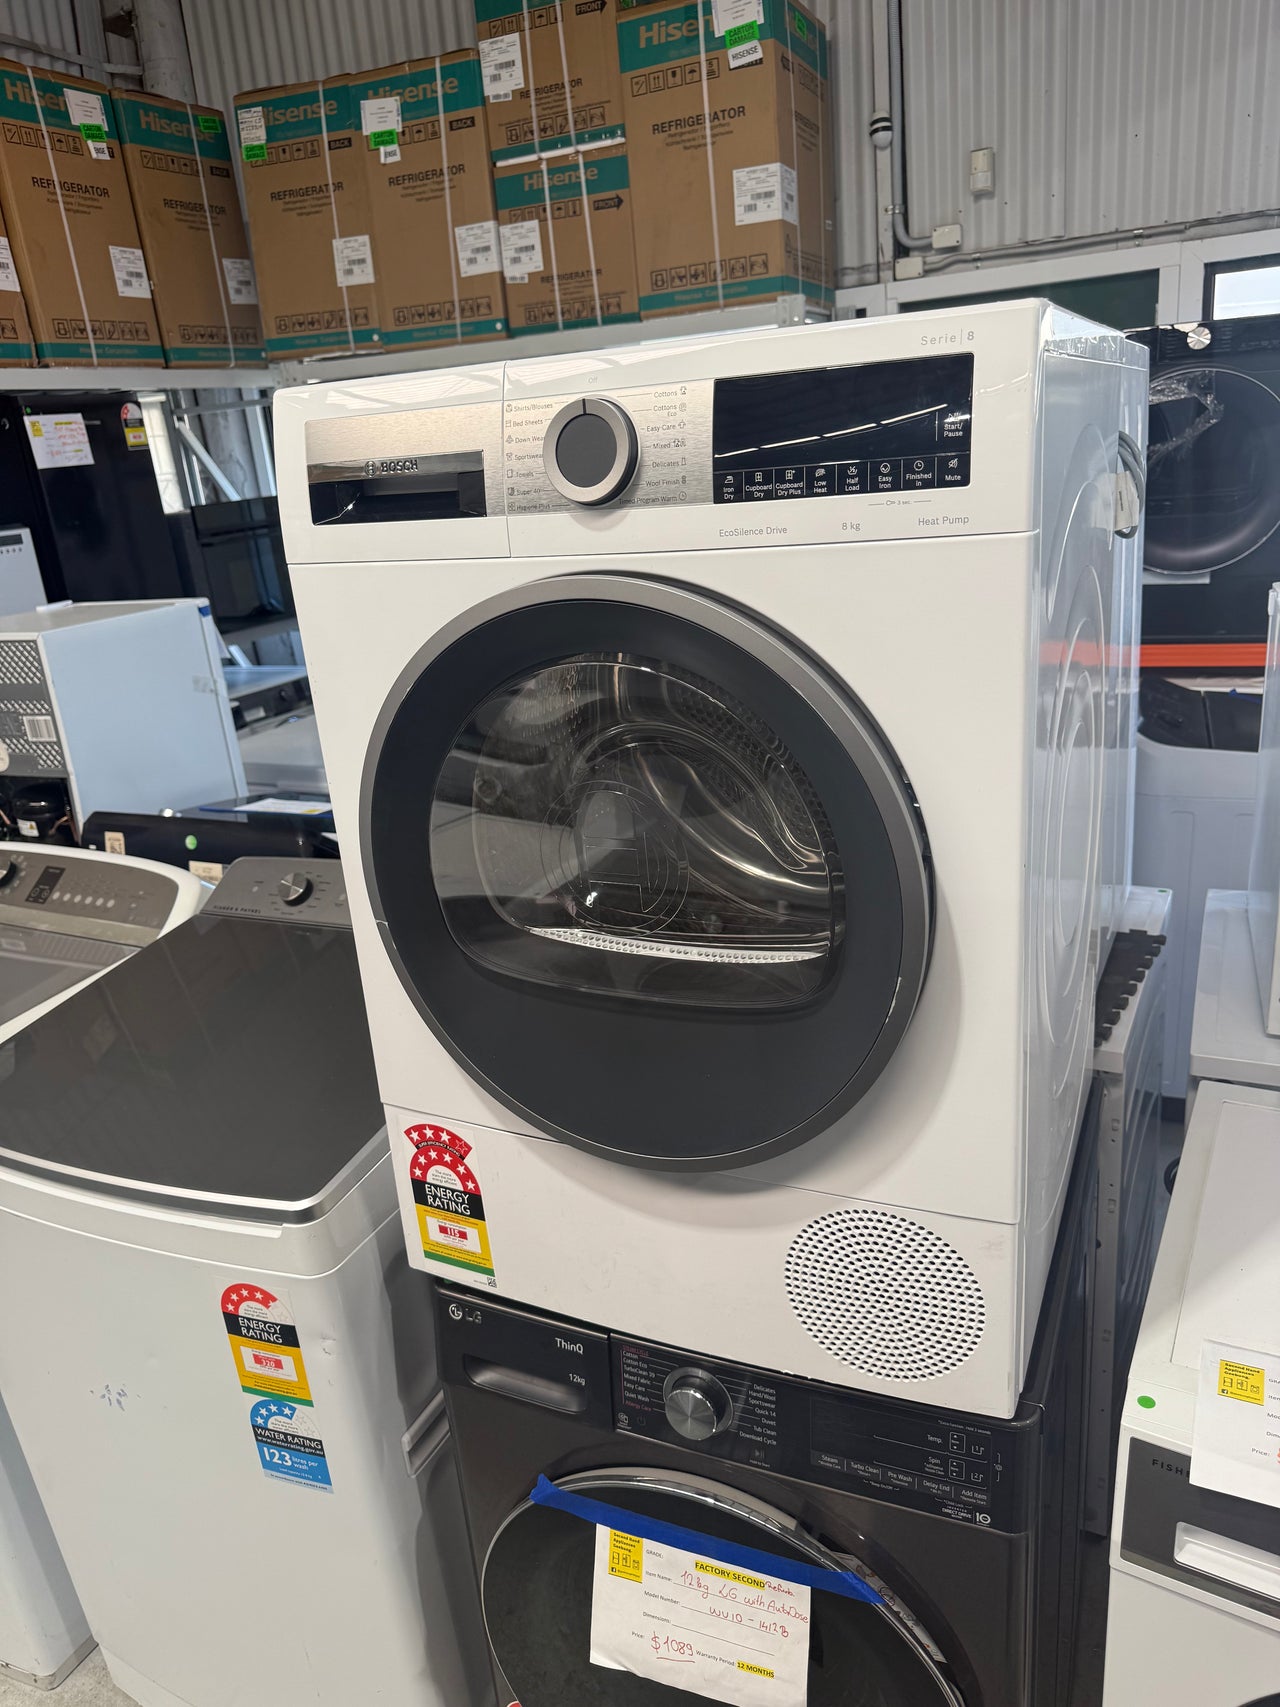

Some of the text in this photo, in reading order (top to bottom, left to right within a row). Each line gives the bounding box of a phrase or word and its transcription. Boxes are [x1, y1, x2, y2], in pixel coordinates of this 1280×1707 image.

[731, 45, 759, 61] HISENSE
[520, 78, 583, 99] RERIGERAOR
[652, 106, 746, 135] REFRIGEATOR
[163, 198, 226, 216] REFRIGERTOR
[920, 330, 975, 346] Serie 8
[653, 391, 678, 399] Cottons
[653, 404, 678, 412] Cottons
[646, 423, 677, 433] Easy Care
[943, 430, 963, 438] Pause
[381, 460, 418, 475] BOSCH
[906, 472, 932, 480] Finished
[745, 483, 773, 492] Cupboard
[775, 481, 804, 490] Cupboard
[777, 489, 788, 497] Dry
[813, 486, 828, 494] Heat
[844, 484, 860, 492] Load
[841, 521, 861, 532] 8 kg
[918, 515, 970, 527] Heat Pump
[719, 525, 788, 538] EcoSilence Drive
[425, 1184, 469, 1204] ENERGY
[427, 1195, 471, 1215] RATING
[447, 1227, 460, 1238] 115
[238, 1317, 281, 1334] ENERGY
[240, 1326, 283, 1344] RATING
[555, 1337, 584, 1355] ThinQ
[568, 1372, 586, 1387] 12kg
[754, 1407, 769, 1416] Quick
[254, 1427, 322, 1449] WATER RATING
[263, 1446, 293, 1467] 123
[645, 1548, 664, 1559] GRADE:
[694, 1561, 731, 1578] FACTORY
[731, 1572, 766, 1589] SECOND
[645, 1570, 657, 1579] Item
[656, 1573, 673, 1583] Name:
[718, 1583, 738, 1600] LG
[743, 1594, 765, 1607] with
[644, 1590, 659, 1600] Model
[659, 1595, 681, 1606] Number:
[642, 1611, 672, 1624] Dimensions:
[631, 1630, 776, 1679] Price: $1089 Warranty Period: 12 MONTHS
